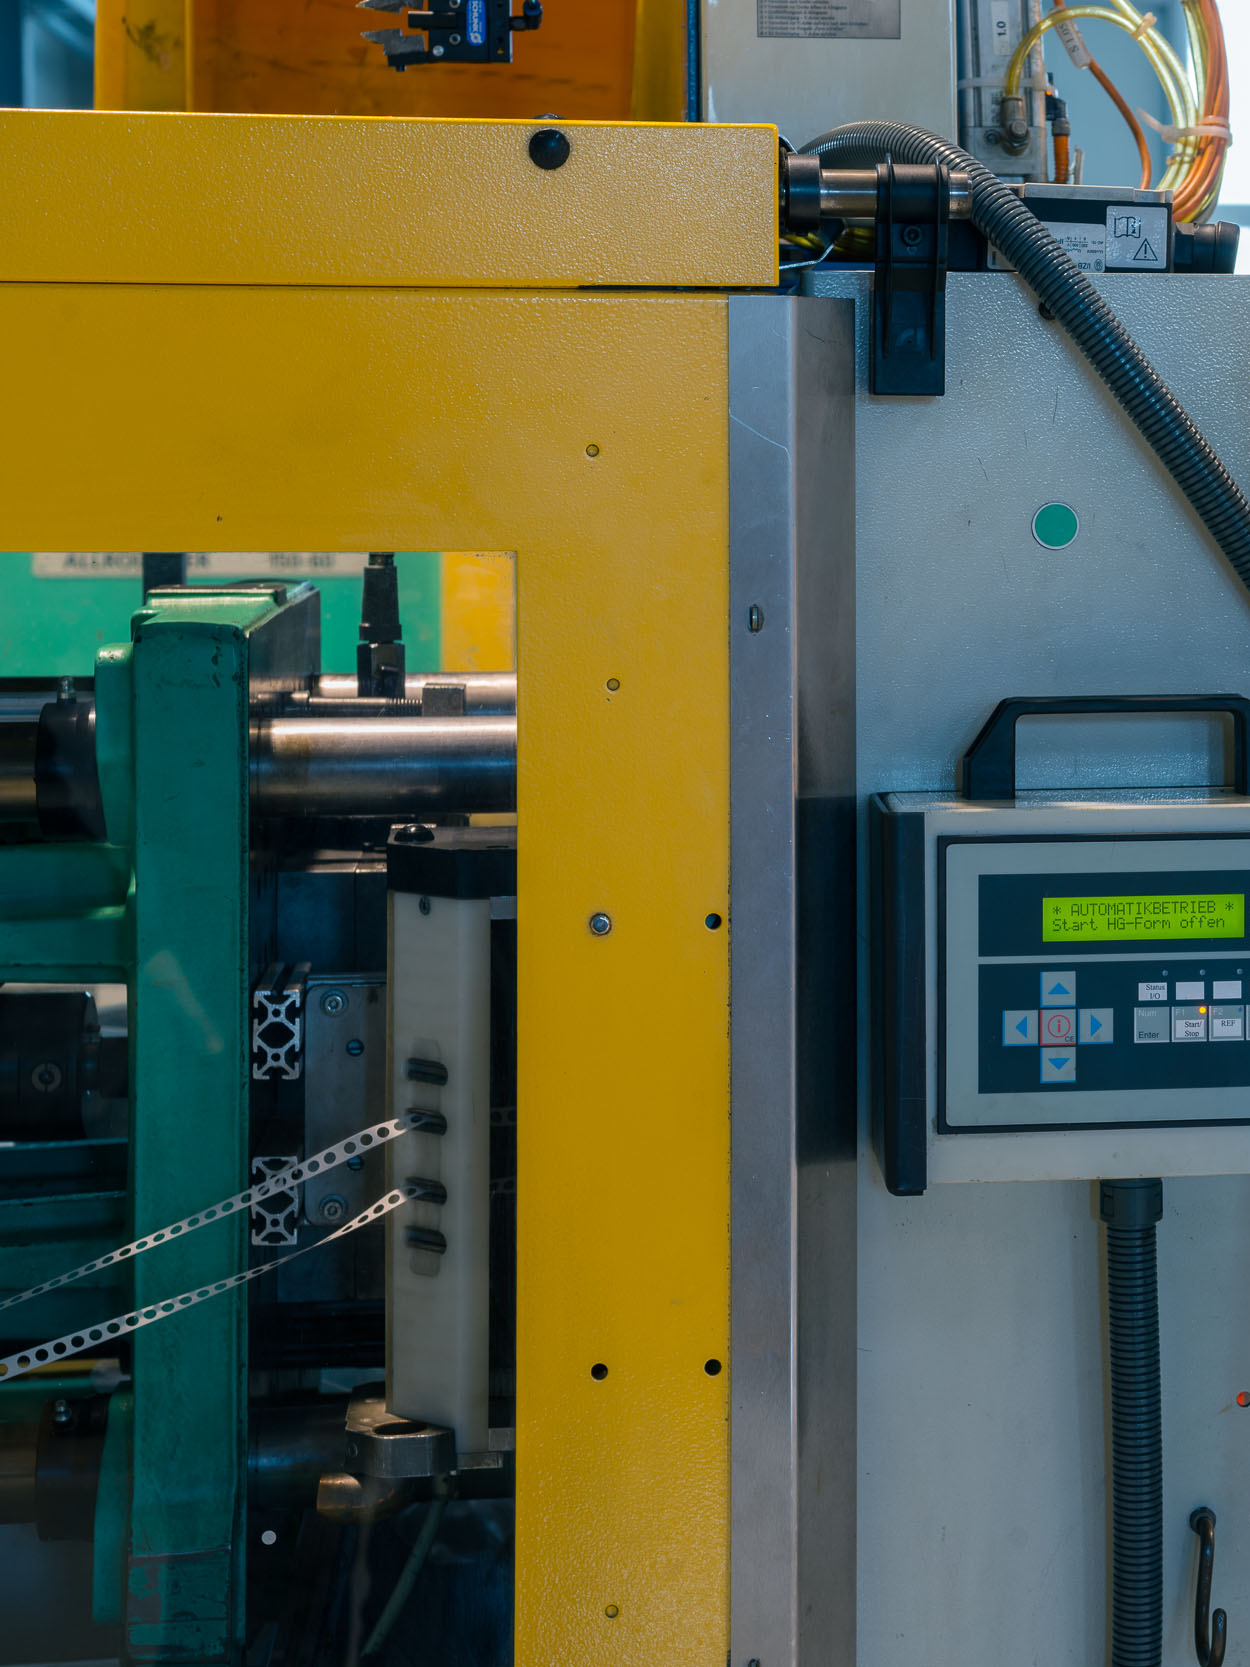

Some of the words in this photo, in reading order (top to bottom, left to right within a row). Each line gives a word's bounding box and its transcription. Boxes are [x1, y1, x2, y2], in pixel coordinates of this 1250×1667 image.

[1070, 900, 1216, 917] AUTOMATIKBETRIEB
[1052, 918, 1098, 932] Start
[1107, 916, 1171, 930] HG-Form
[1180, 916, 1225, 930] offen
[1184, 1030, 1200, 1038] Stop
